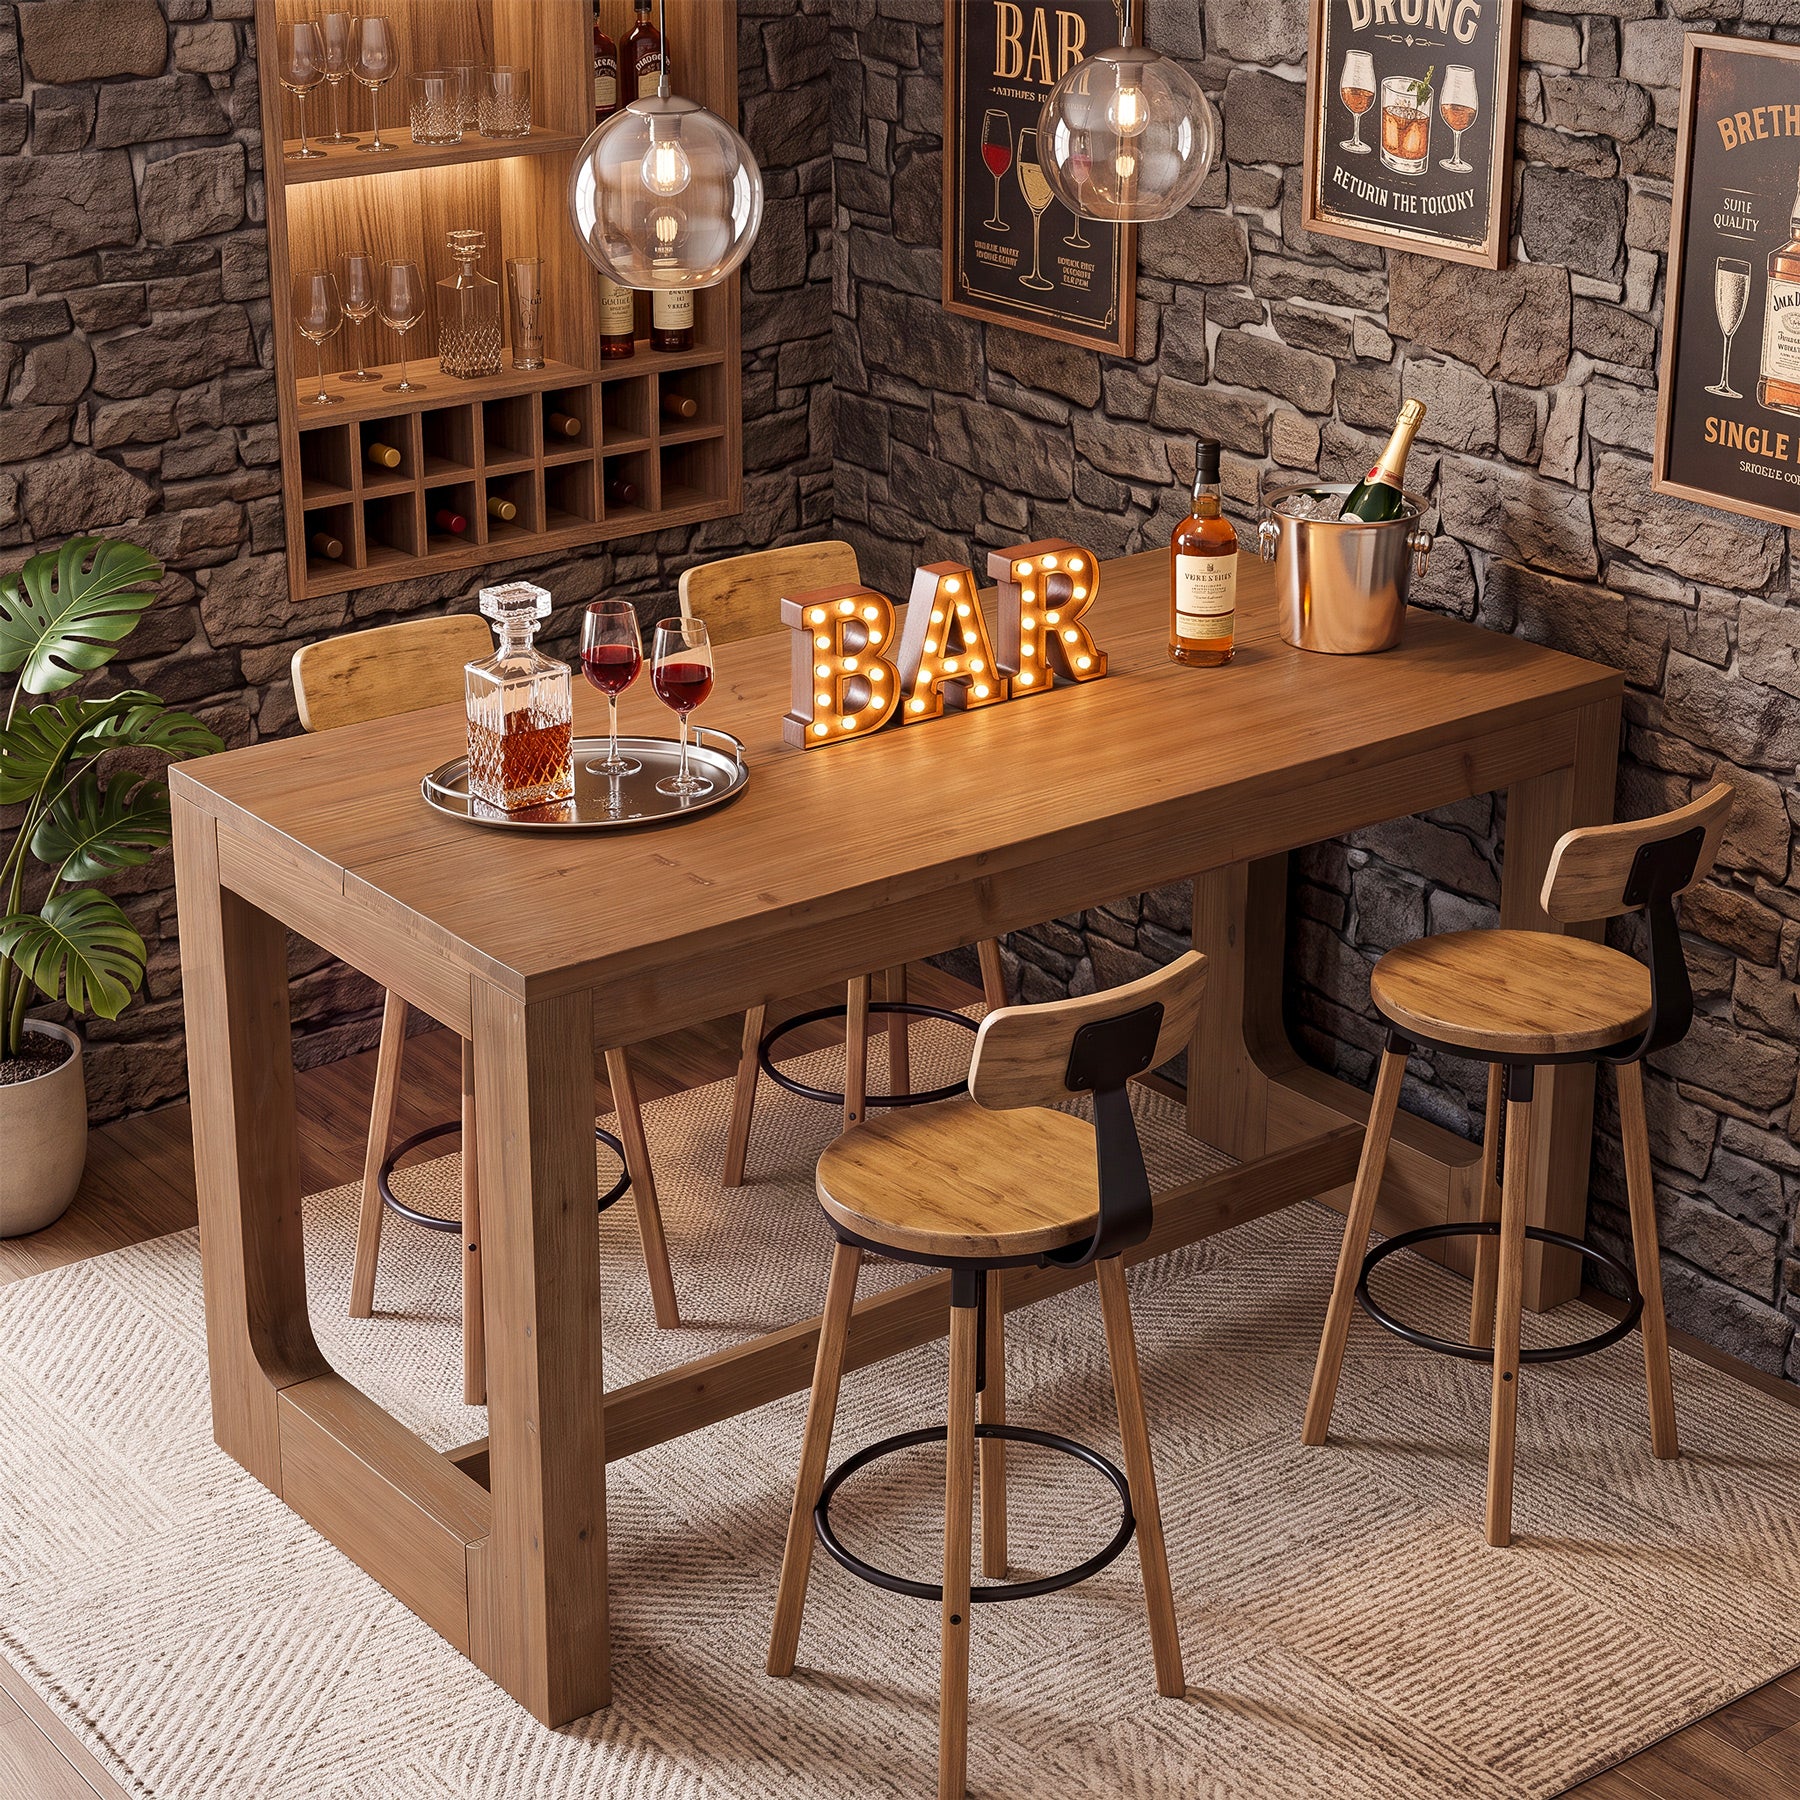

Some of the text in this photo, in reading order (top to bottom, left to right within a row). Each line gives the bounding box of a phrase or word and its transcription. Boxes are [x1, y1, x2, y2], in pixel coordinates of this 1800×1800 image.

[993, 1, 1086, 86] BAR
[1392, 191, 1418, 215] THE
[1713, 213, 1760, 232] QUALITY
[1704, 416, 1790, 461] SINGLE
[781, 538, 1108, 750] BAR
